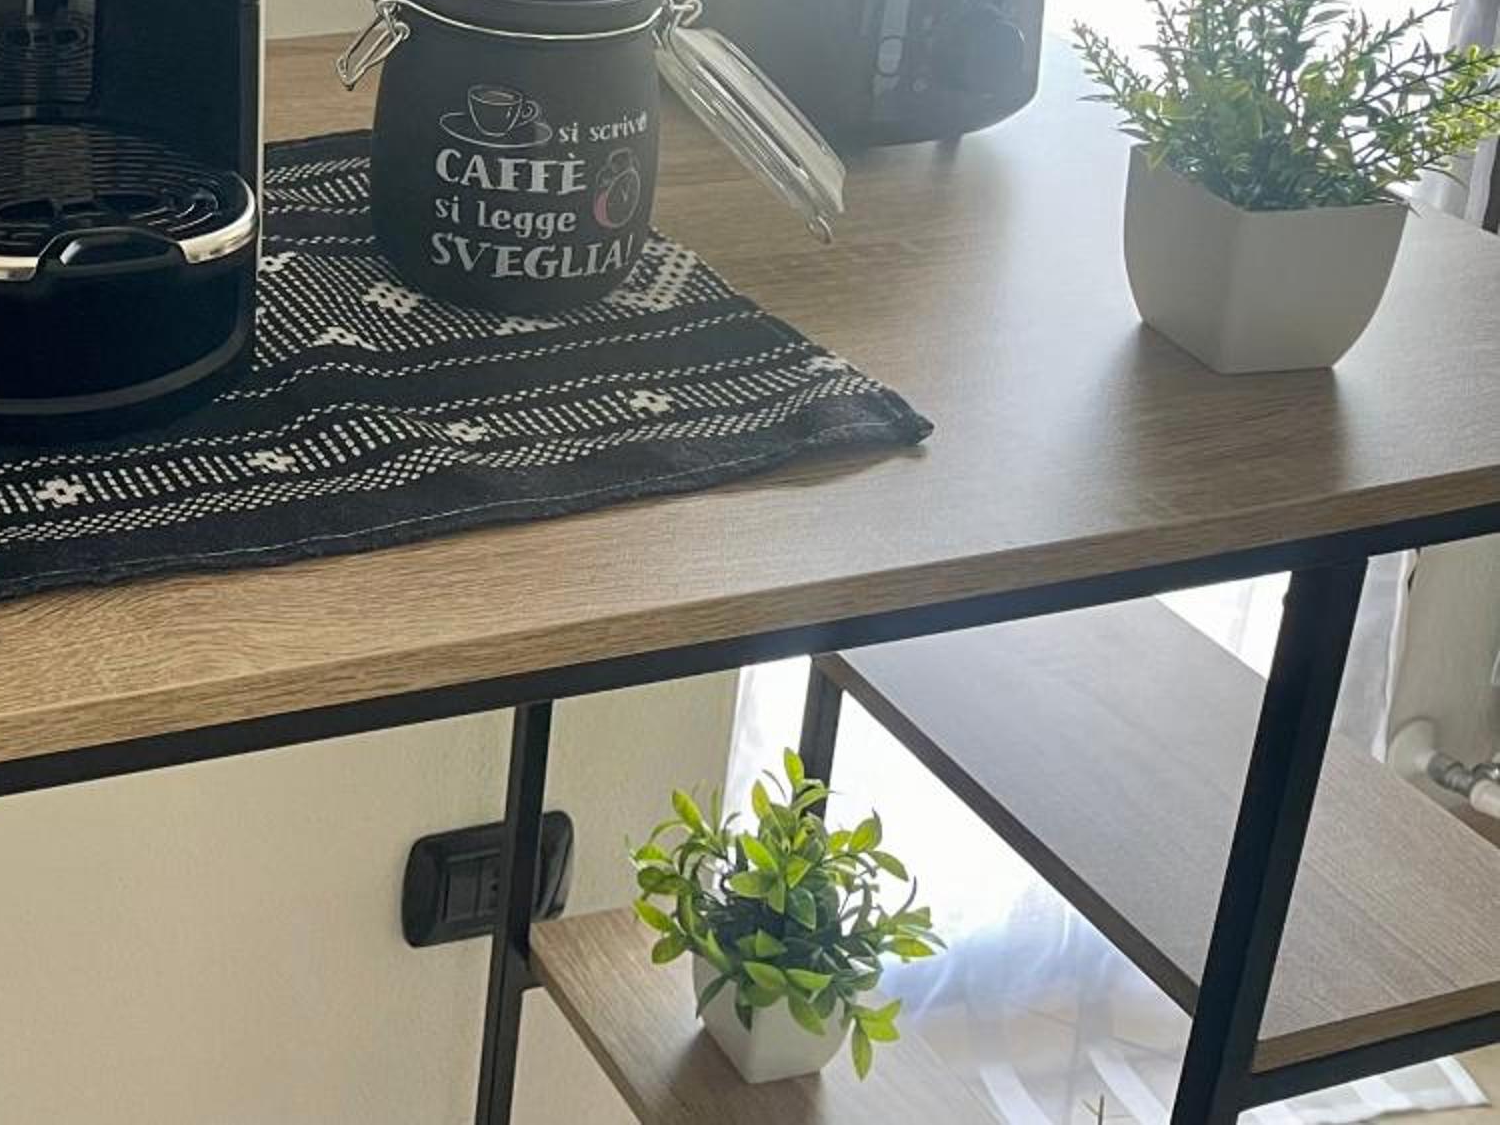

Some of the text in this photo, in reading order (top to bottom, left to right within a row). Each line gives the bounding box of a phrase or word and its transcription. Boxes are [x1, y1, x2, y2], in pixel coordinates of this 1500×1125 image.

[559, 122, 579, 143] si
[435, 148, 588, 195] CAFFÈ
[435, 195, 578, 240] si legge
[431, 234, 633, 280] SVEGLIA!
